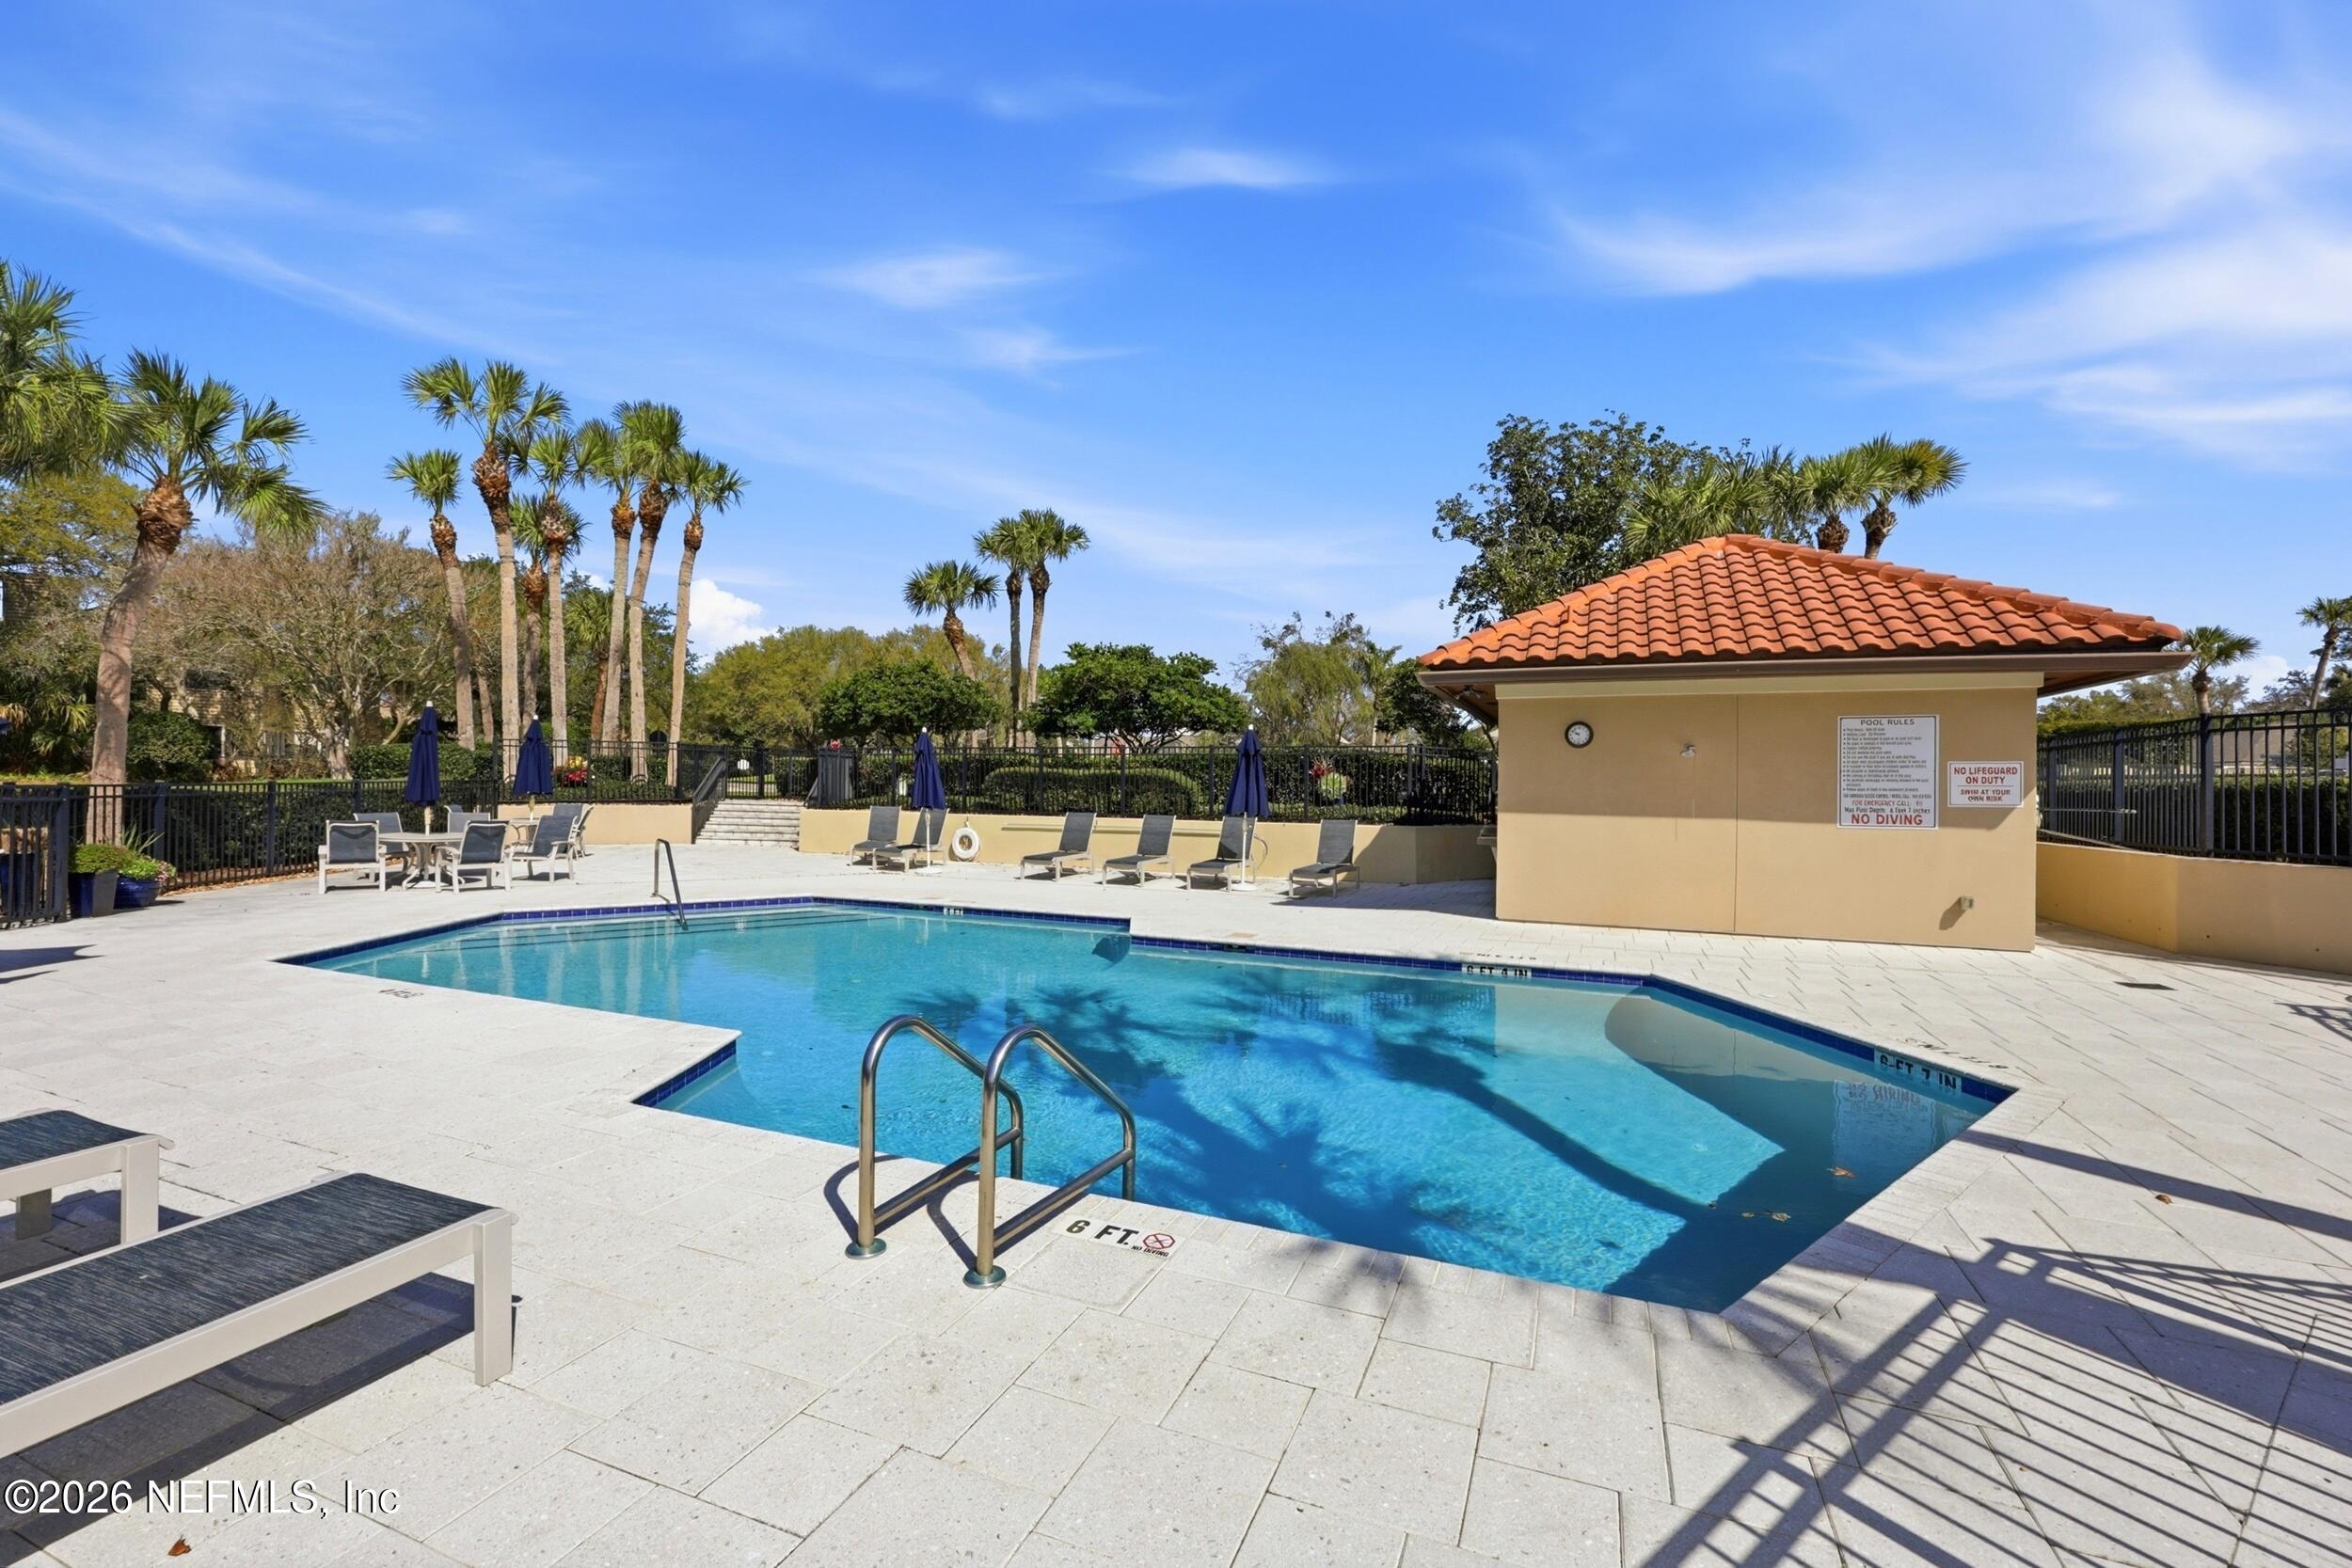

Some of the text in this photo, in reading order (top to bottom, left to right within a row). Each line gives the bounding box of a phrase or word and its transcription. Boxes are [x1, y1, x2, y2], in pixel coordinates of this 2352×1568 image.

[1954, 767, 2018, 775] NO LIFEGUARD
[1965, 776, 2006, 784] ON DUTY
[1851, 814, 1923, 826] NO DIVING
[1480, 966, 1494, 974] FT
[1896, 1059, 1914, 1074] FT
[1921, 1068, 1931, 1080] 7
[1938, 1072, 1957, 1089] IN
[1066, 1219, 1140, 1246] 6 FT.
[1143, 1247, 1170, 1258] DIVING
